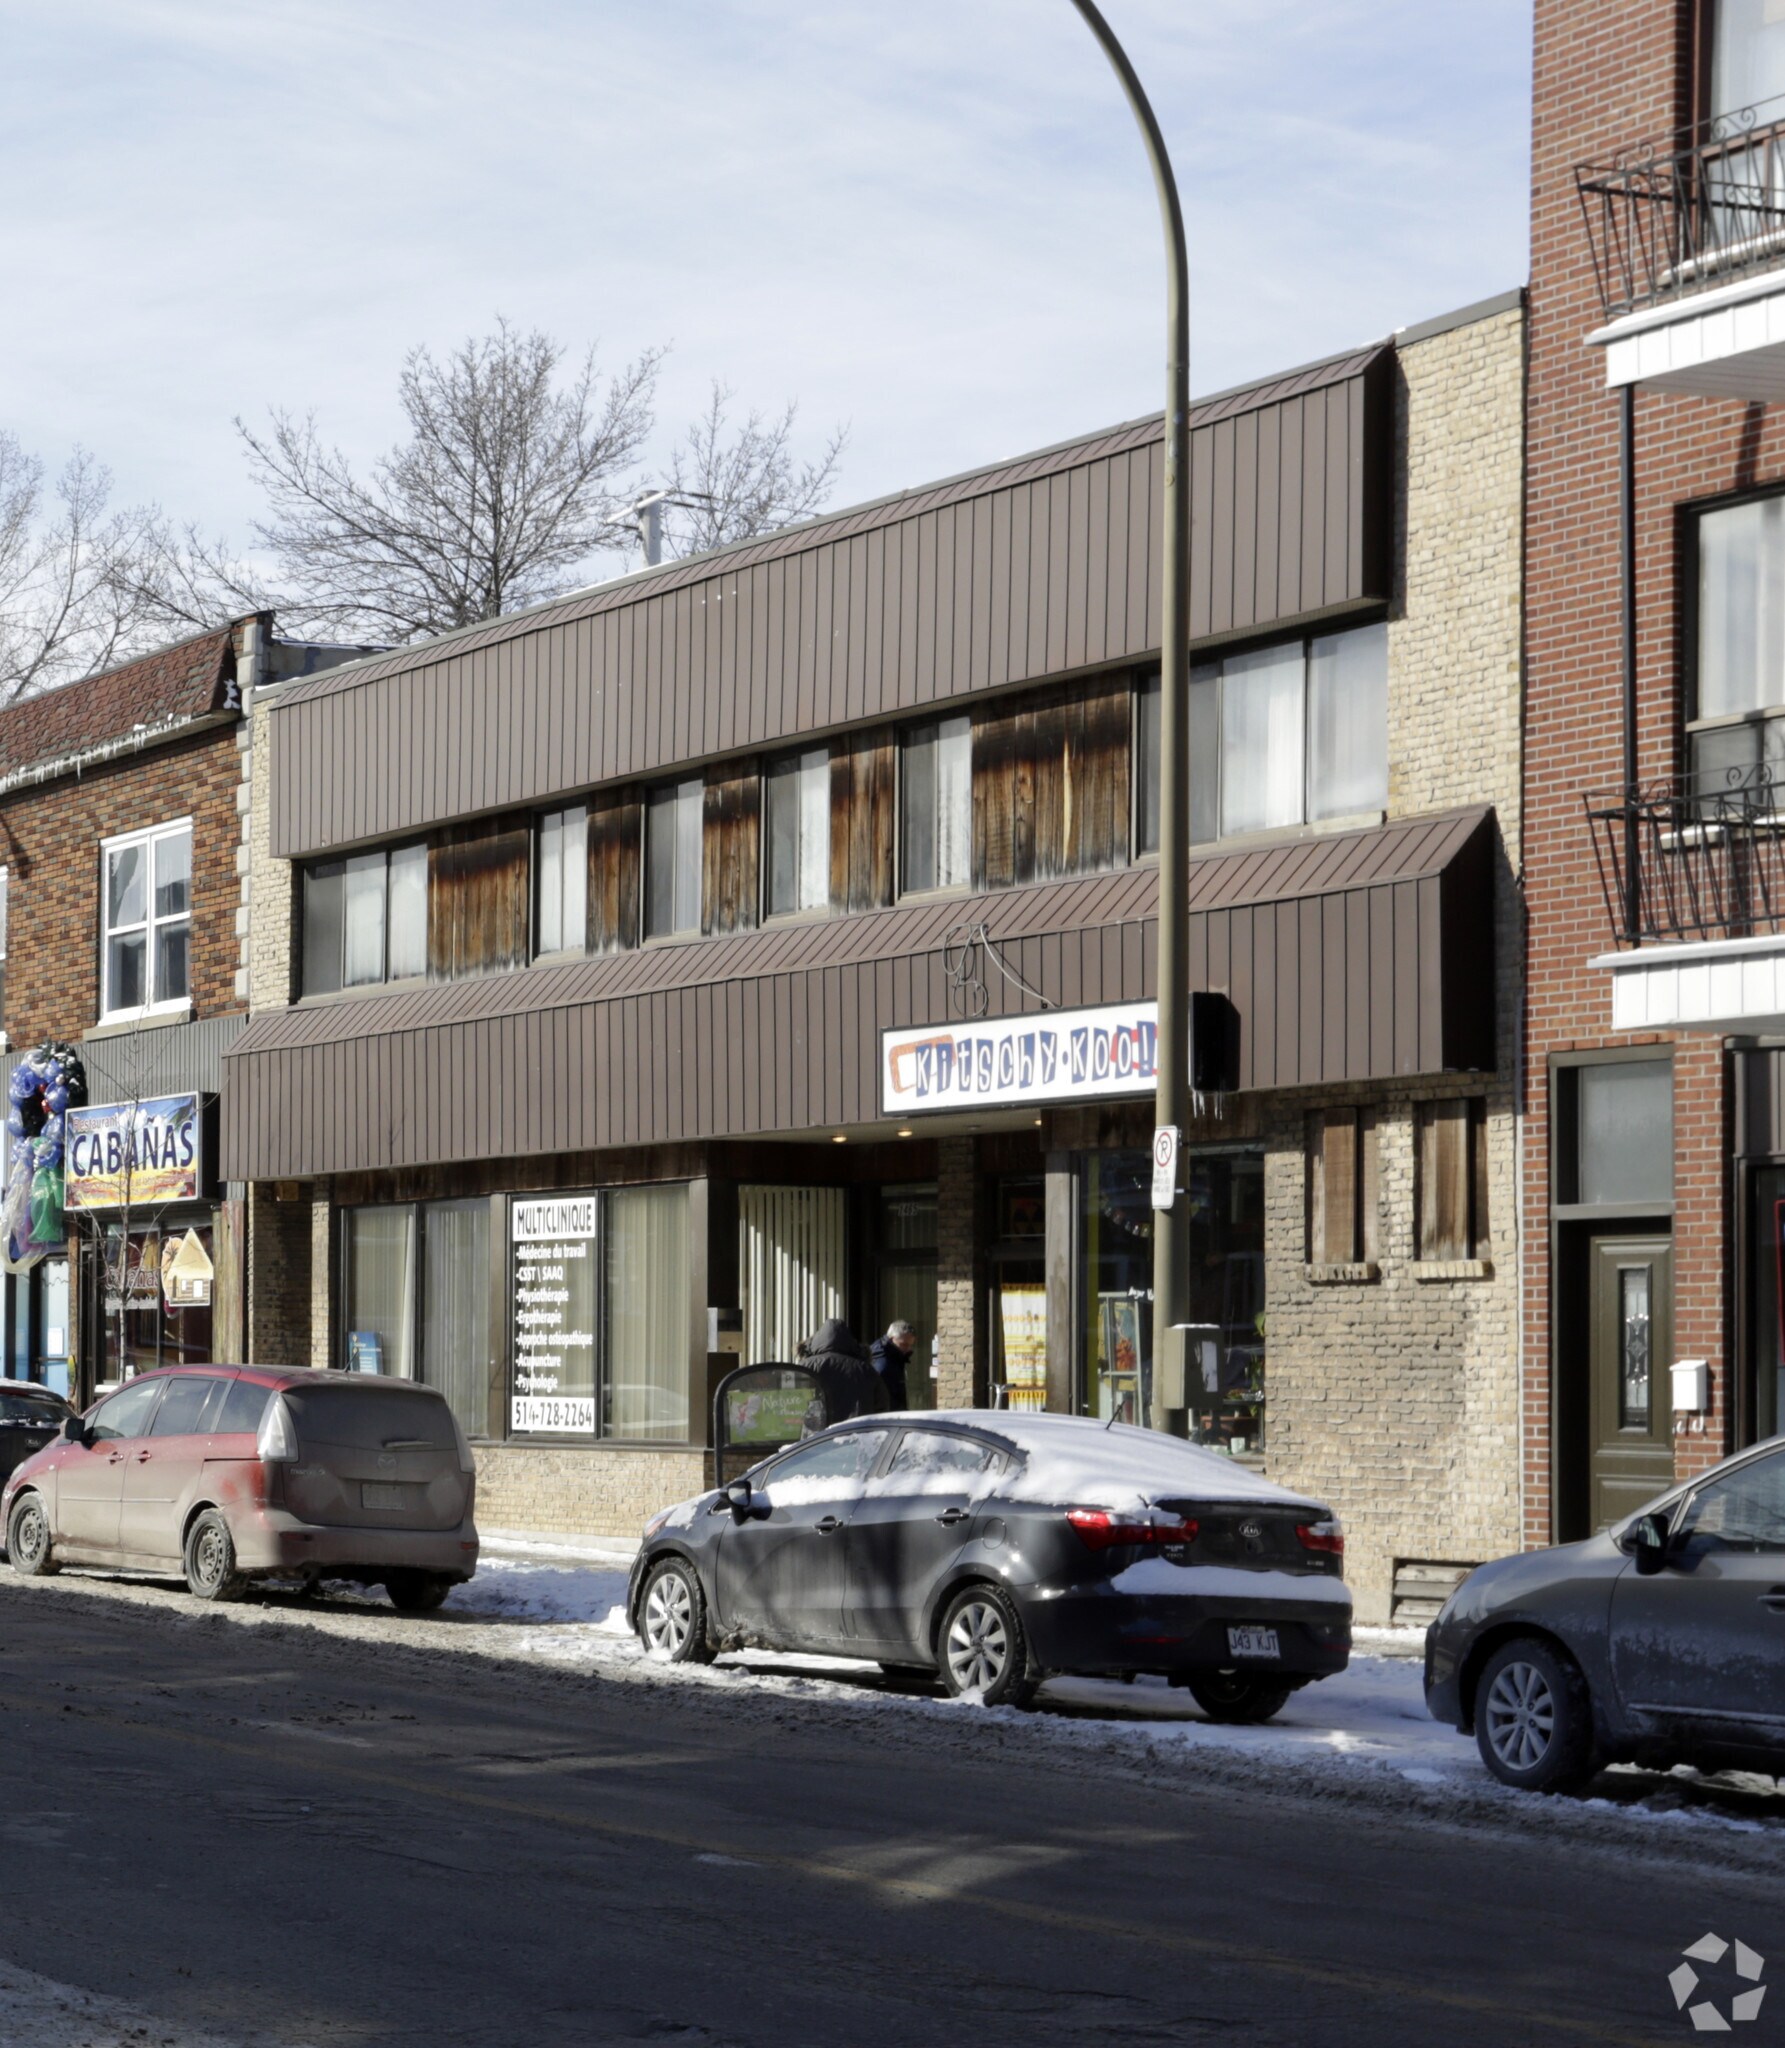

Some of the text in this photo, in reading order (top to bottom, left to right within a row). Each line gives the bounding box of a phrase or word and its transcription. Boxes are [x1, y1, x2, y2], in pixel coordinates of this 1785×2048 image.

[72, 1115, 119, 1133] Restaurant
[517, 1203, 592, 1235] MULTICLINIQUE
[552, 1243, 563, 1258] du
[563, 1242, 586, 1258] travail
[542, 1265, 564, 1282] SAAQ
[549, 1330, 593, 1352] ostéopathique
[515, 1401, 592, 1427] 514-728-2264
[1231, 1633, 1277, 1651] J43 KJT
